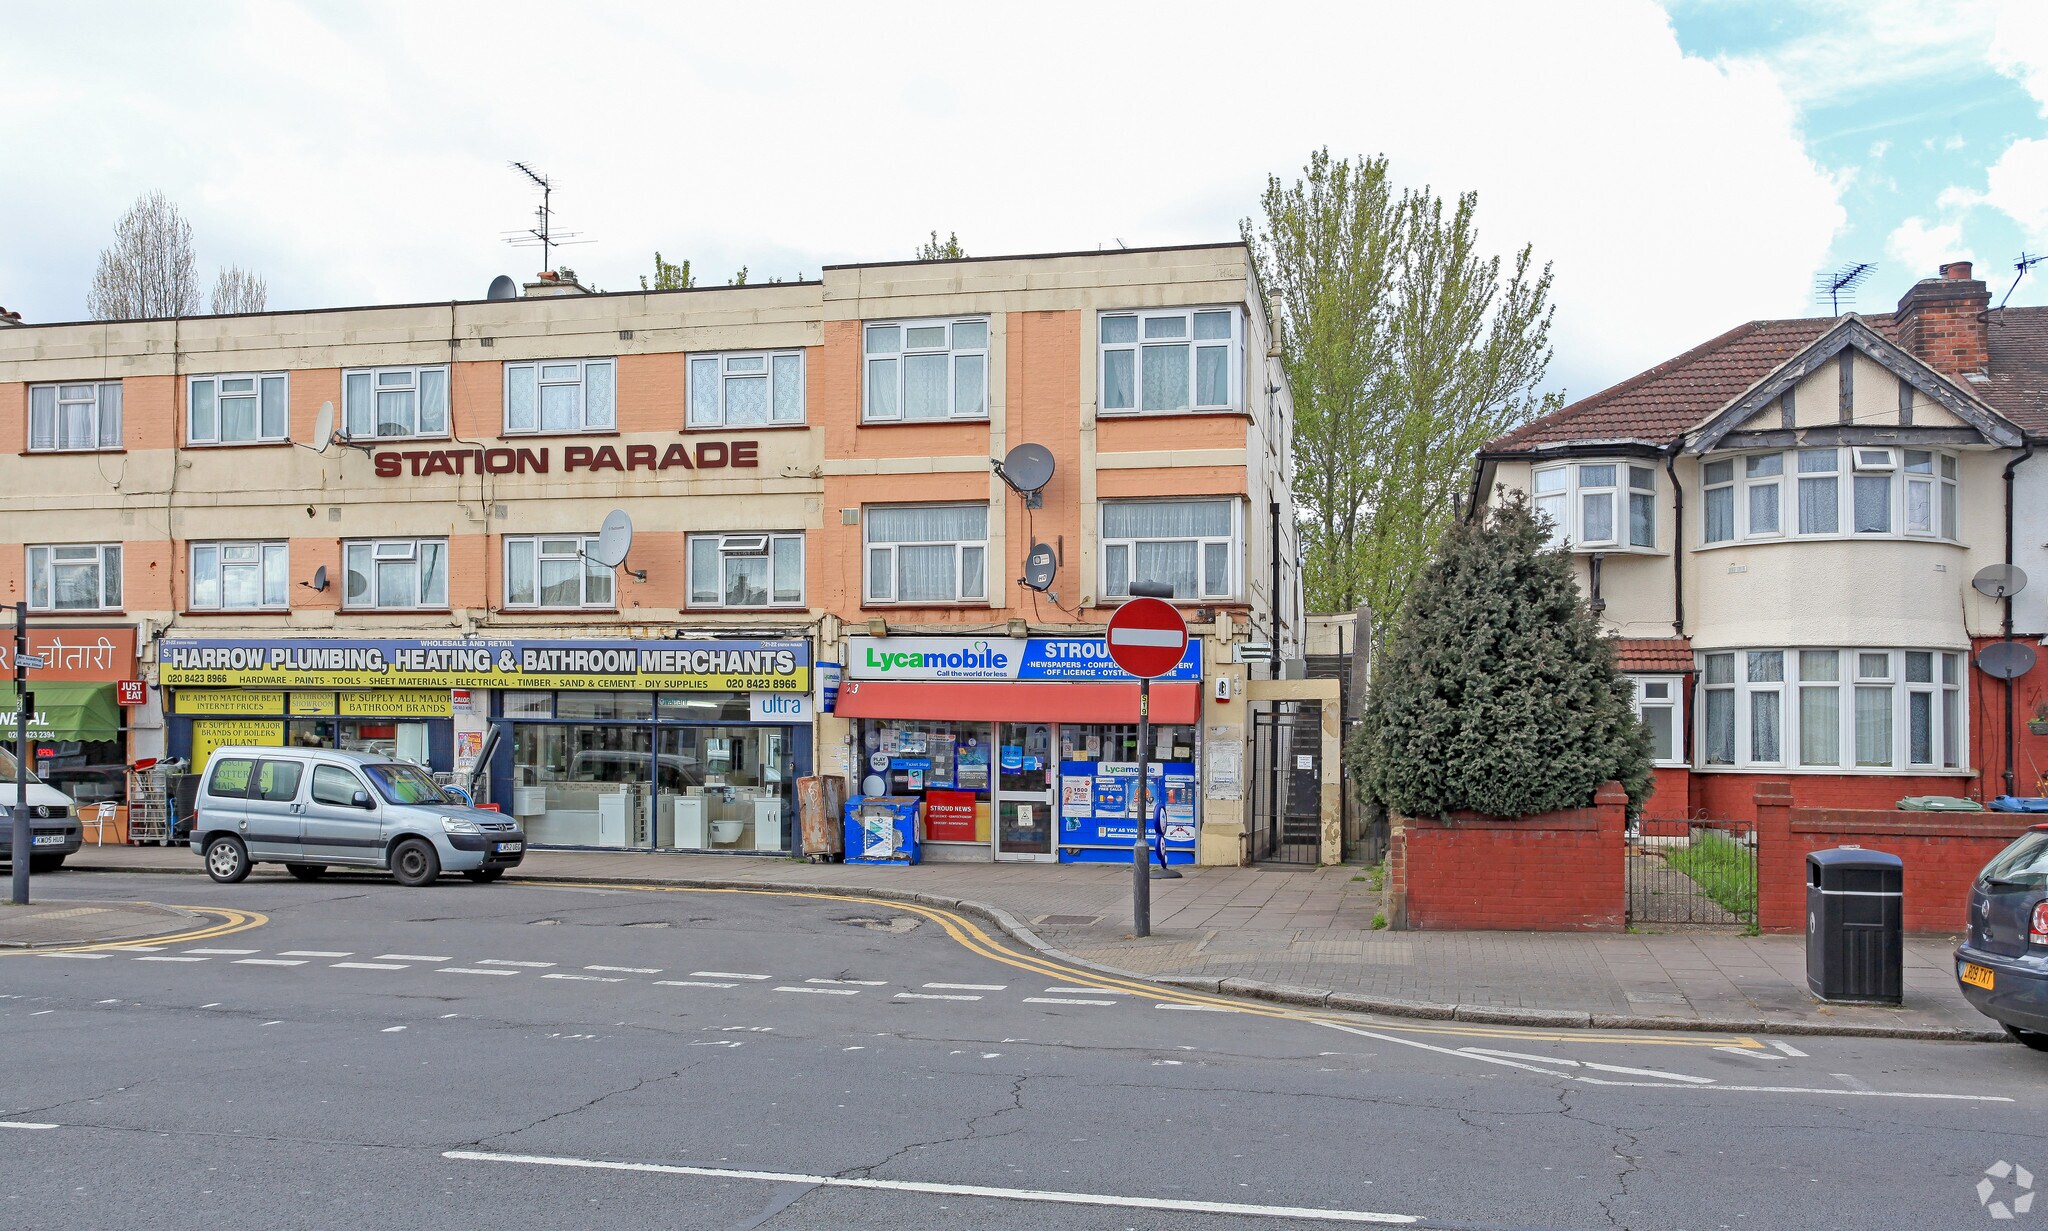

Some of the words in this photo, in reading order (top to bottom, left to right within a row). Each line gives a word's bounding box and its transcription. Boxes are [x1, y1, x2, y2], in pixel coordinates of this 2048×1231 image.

[374, 447, 549, 478] STATION
[564, 441, 759, 472] PARADE
[1045, 642, 1111, 658] STROU
[172, 648, 265, 670] HARROW
[270, 648, 389, 675] PLUMBING,
[395, 649, 492, 672] HEATING
[498, 649, 519, 673] &
[523, 650, 637, 673] BATHROOM
[641, 650, 795, 674] MERCHANTS
[866, 647, 1008, 672] Lycamobile
[168, 674, 182, 683] 020
[184, 674, 204, 683] 8423
[207, 674, 227, 683] 8966
[332, 677, 361, 685] TOOLS
[398, 678, 448, 686] MATERIALS
[456, 678, 509, 686] ELECTRICAL
[517, 678, 551, 686] TIMBER
[560, 679, 585, 687] SAND
[598, 680, 637, 688] CEMENT
[645, 680, 661, 688] DIY
[664, 680, 708, 688] SUPPLIES
[121, 682, 142, 690] JUST
[726, 679, 744, 688] 020
[746, 679, 770, 688] 8423
[772, 680, 797, 689] 8966
[126, 691, 142, 700] EAT
[342, 694, 356, 702] WE
[358, 694, 395, 702] SUPPLY
[350, 704, 403, 712] BATHROOM
[406, 704, 446, 712] BRANDS
[762, 694, 800, 714] ultra
[0, 712, 50, 726] NEAL
[38, 748, 54, 756] OPEN
[1105, 765, 1155, 774] Lycamole
[1980, 968, 1992, 984] TXT
